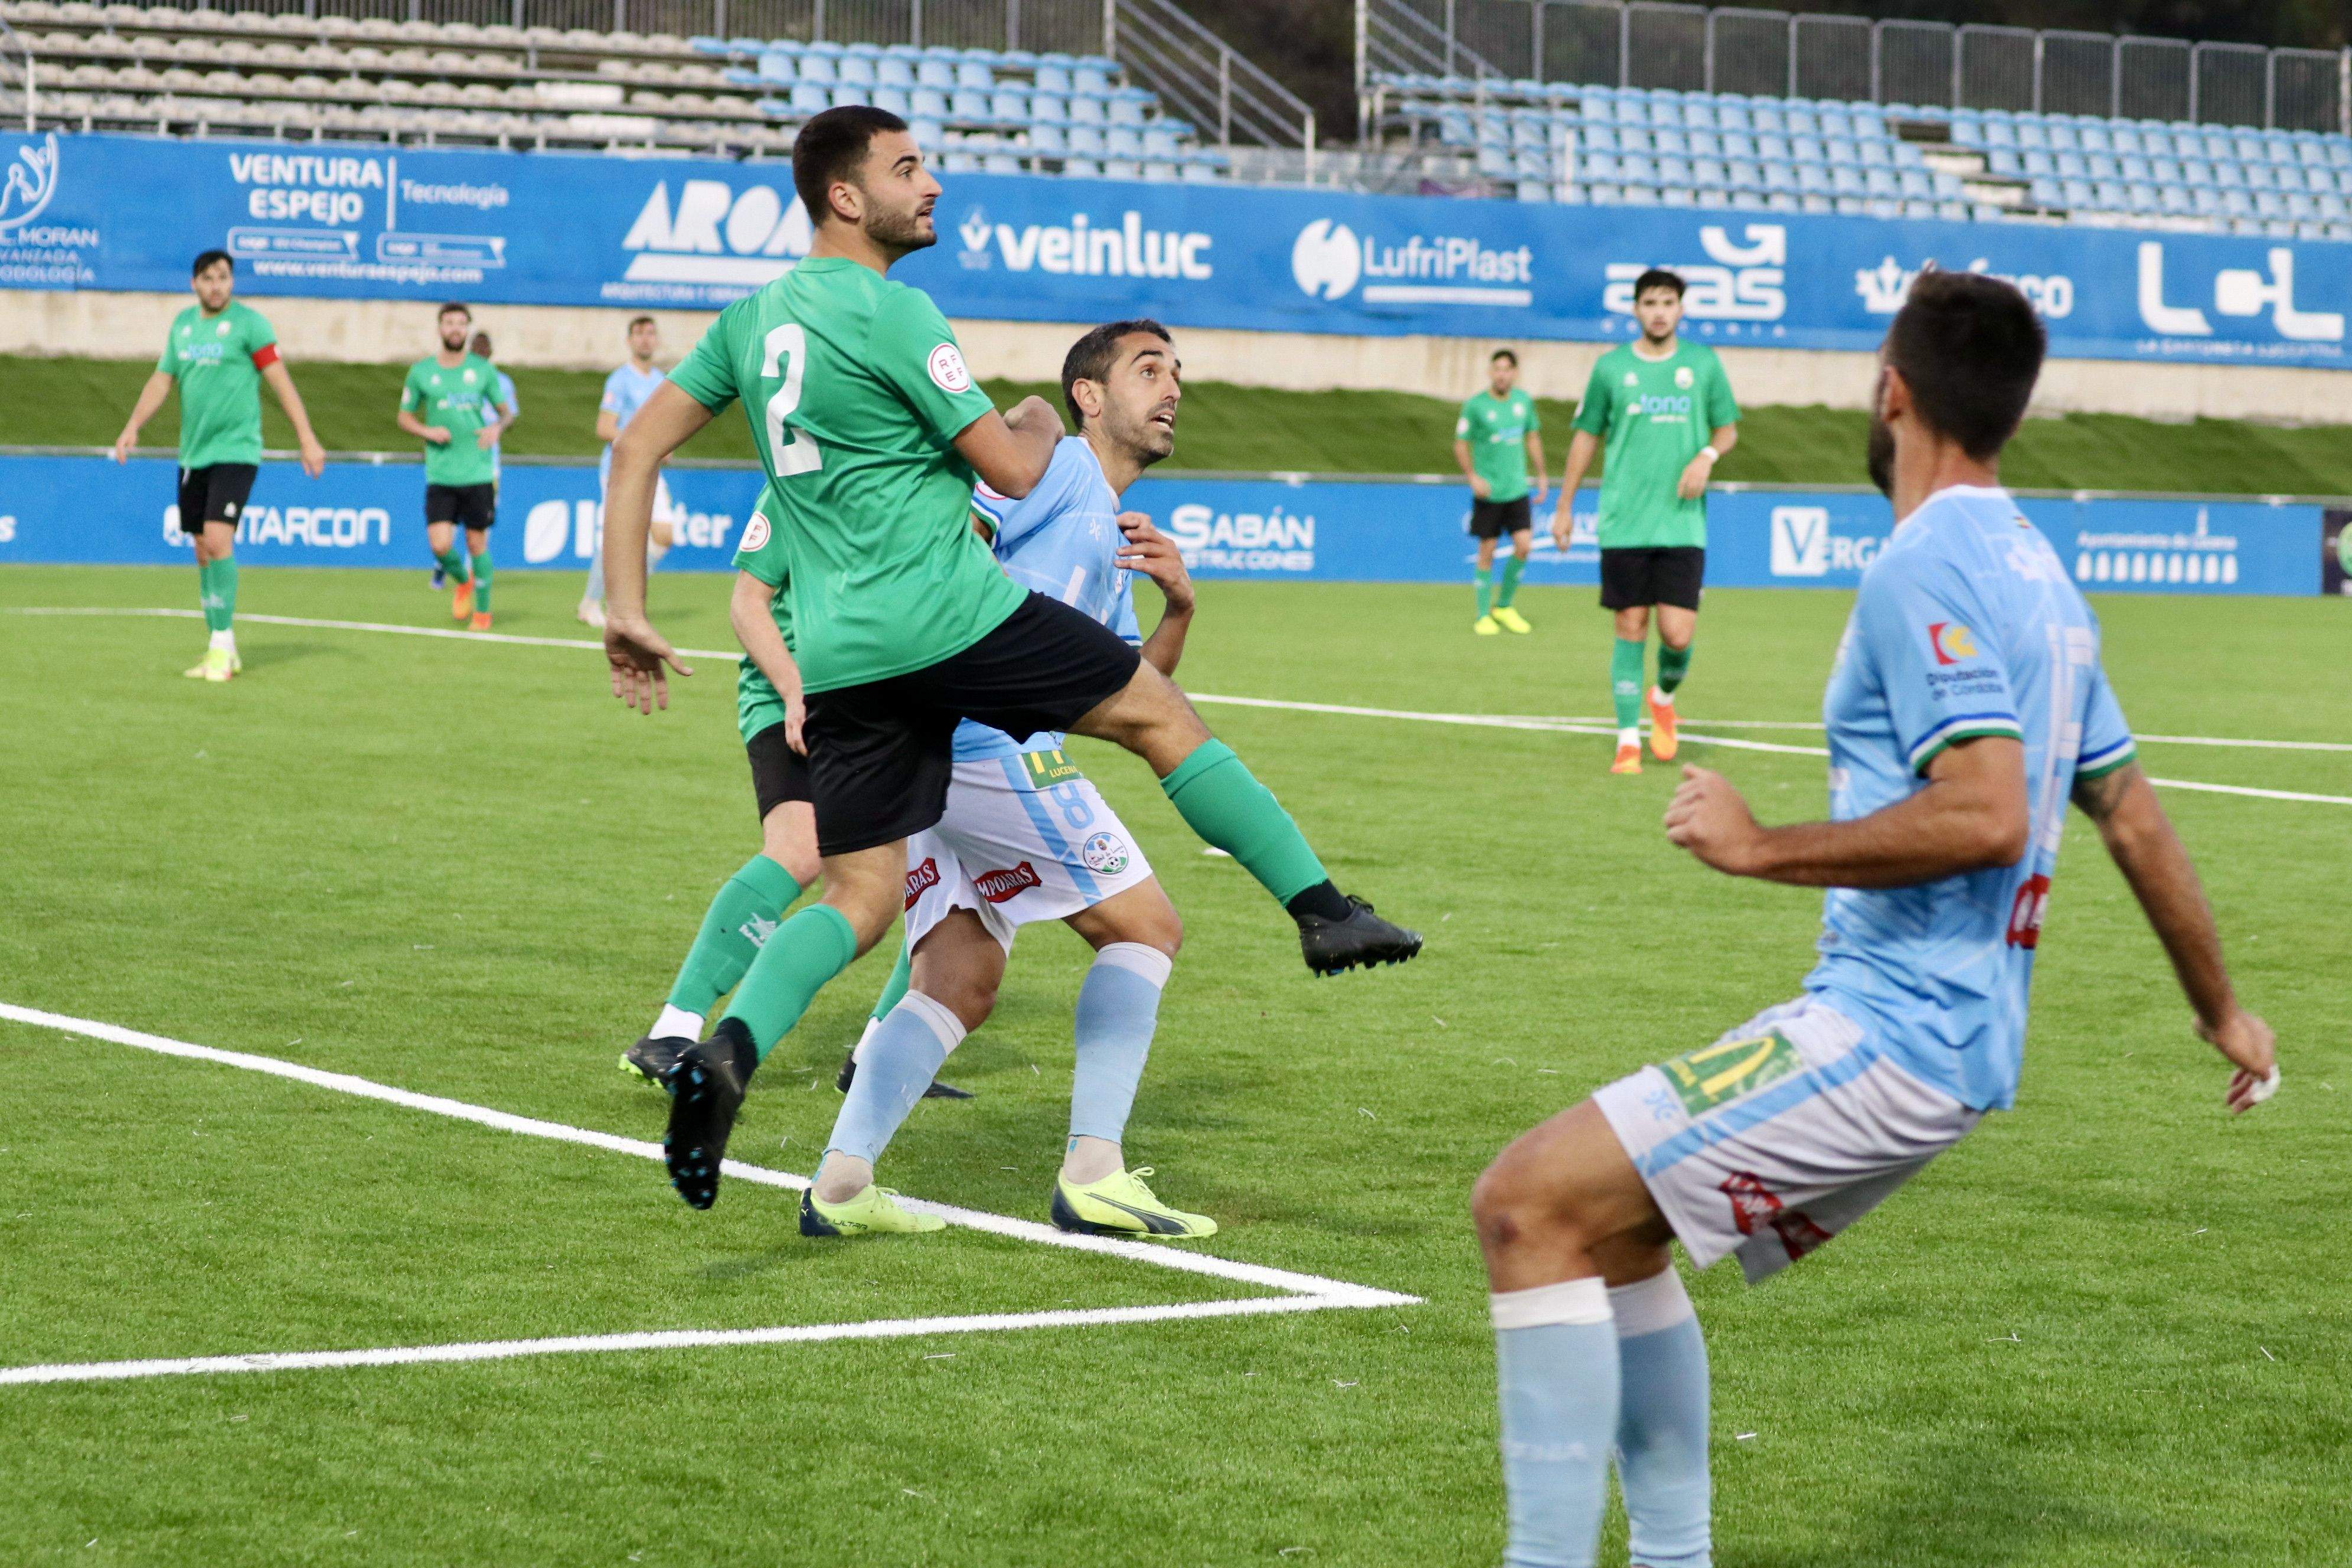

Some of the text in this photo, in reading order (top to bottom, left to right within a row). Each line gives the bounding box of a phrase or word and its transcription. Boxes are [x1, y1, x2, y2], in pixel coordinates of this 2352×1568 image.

[229, 153, 383, 188] VENTURA
[249, 189, 363, 226] ESPEJO
[995, 211, 1212, 279] veinluc
[1364, 235, 1533, 283] LufriPlast
[761, 324, 822, 477] 2
[1171, 504, 1315, 549] SABÁN
[1050, 782, 1095, 829] 8
[905, 864, 935, 897] ARAS
